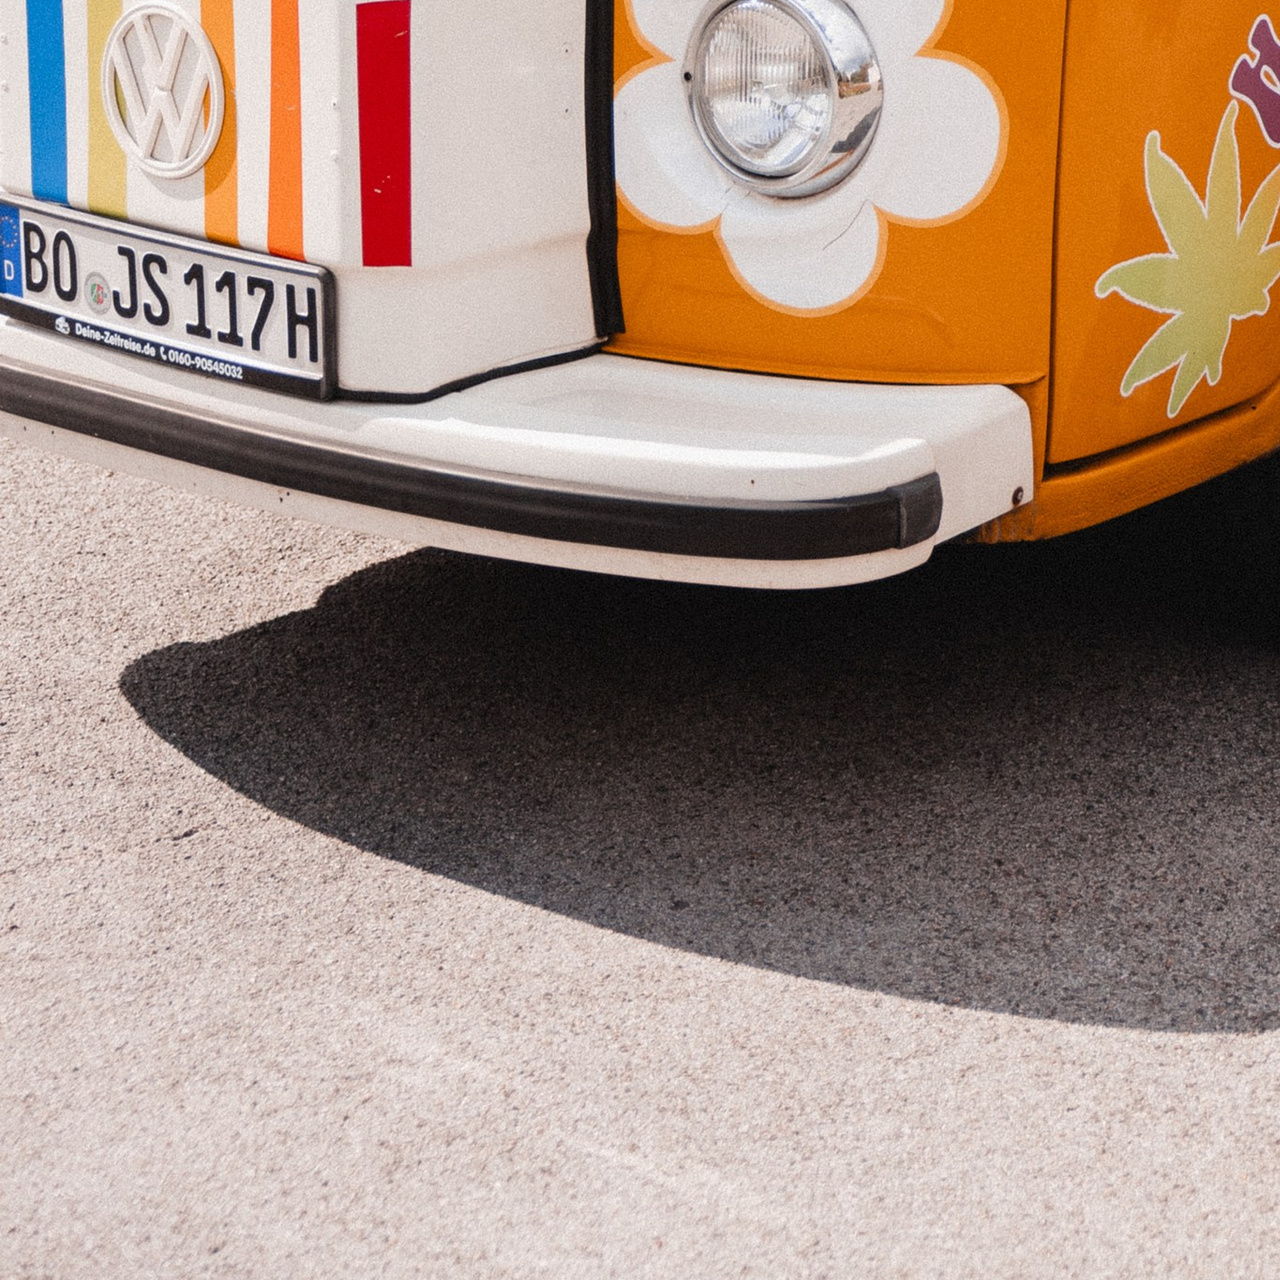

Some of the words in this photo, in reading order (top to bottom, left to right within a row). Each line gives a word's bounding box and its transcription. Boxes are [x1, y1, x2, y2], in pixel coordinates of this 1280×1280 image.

[4, 259, 15, 280] D
[23, 220, 78, 302] BO
[112, 245, 170, 326] JS
[183, 263, 319, 363] 117H
[75, 322, 156, 357] Deine-Zeitreise.de
[168, 349, 243, 380] 0160-90545032
